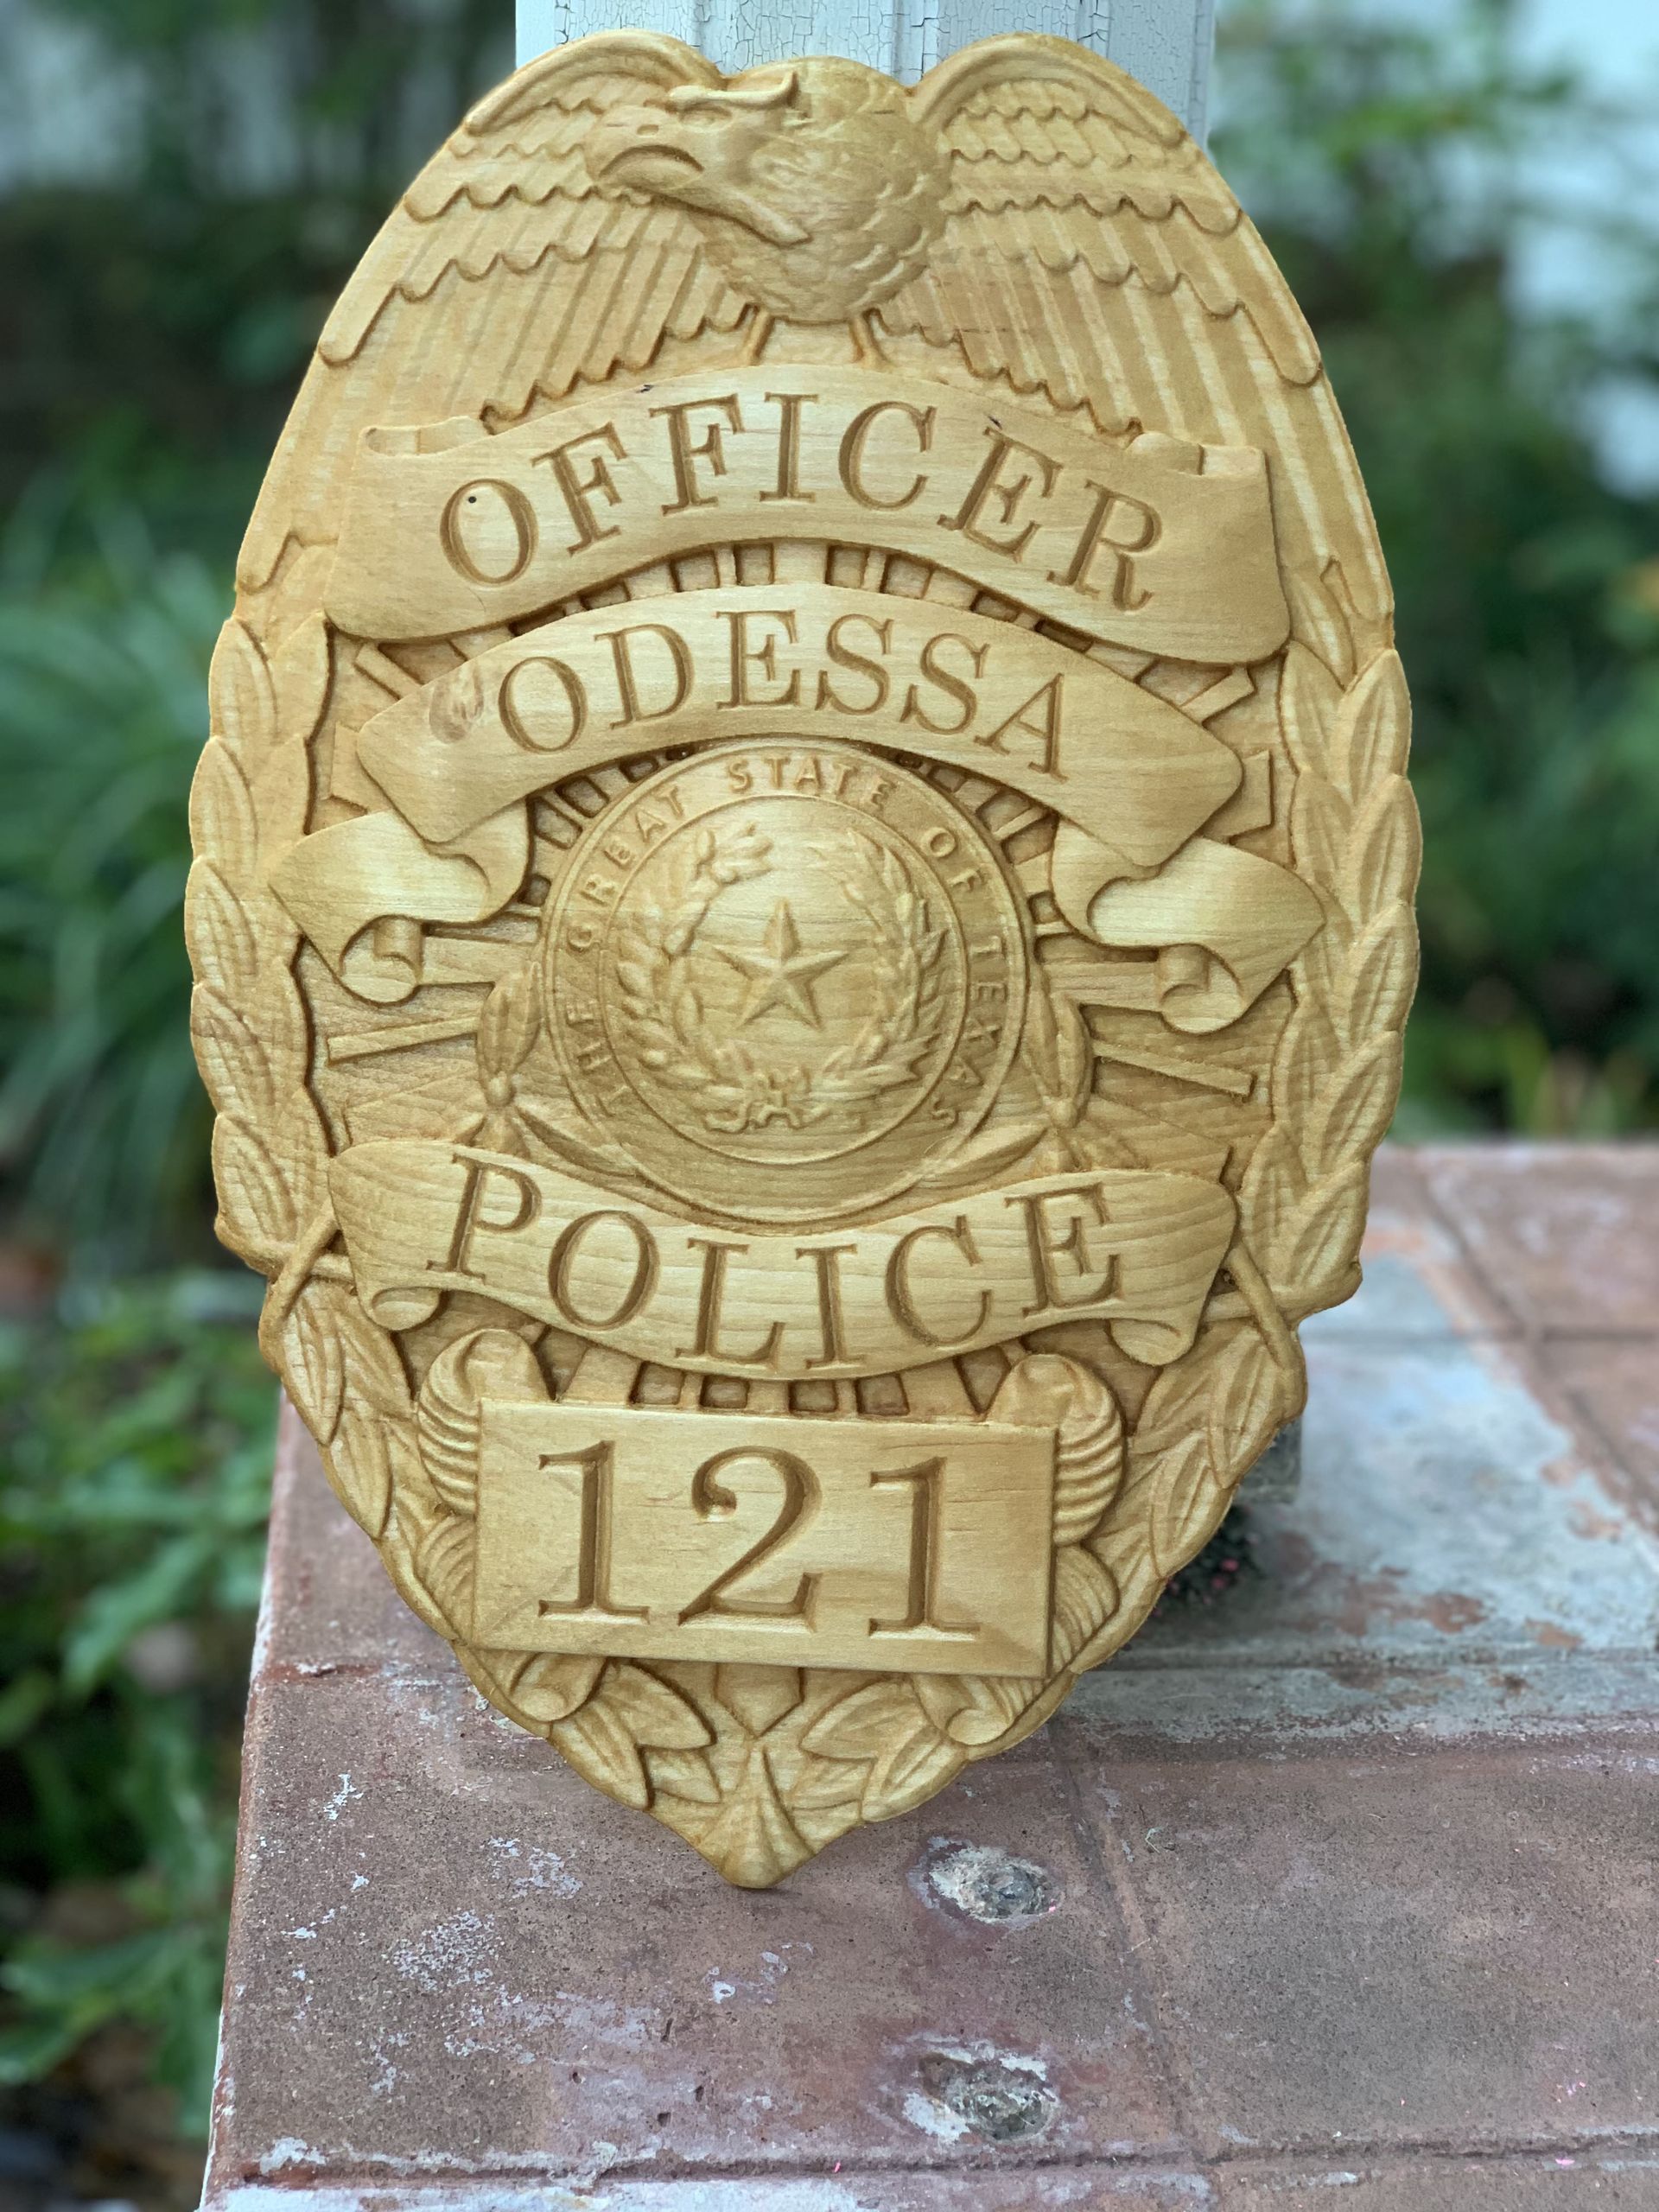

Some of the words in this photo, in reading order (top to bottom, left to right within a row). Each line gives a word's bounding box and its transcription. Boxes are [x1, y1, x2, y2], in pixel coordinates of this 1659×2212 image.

[440, 391, 1163, 612] OFFICER
[497, 609, 1069, 783] ODESSA
[726, 752, 900, 814] STATE
[566, 785, 688, 954] GREAT
[922, 824, 989, 907] OF
[931, 935, 1006, 1122] TEXAS
[425, 1152, 1123, 1371] POLICE
[537, 1440, 986, 1641] 121
